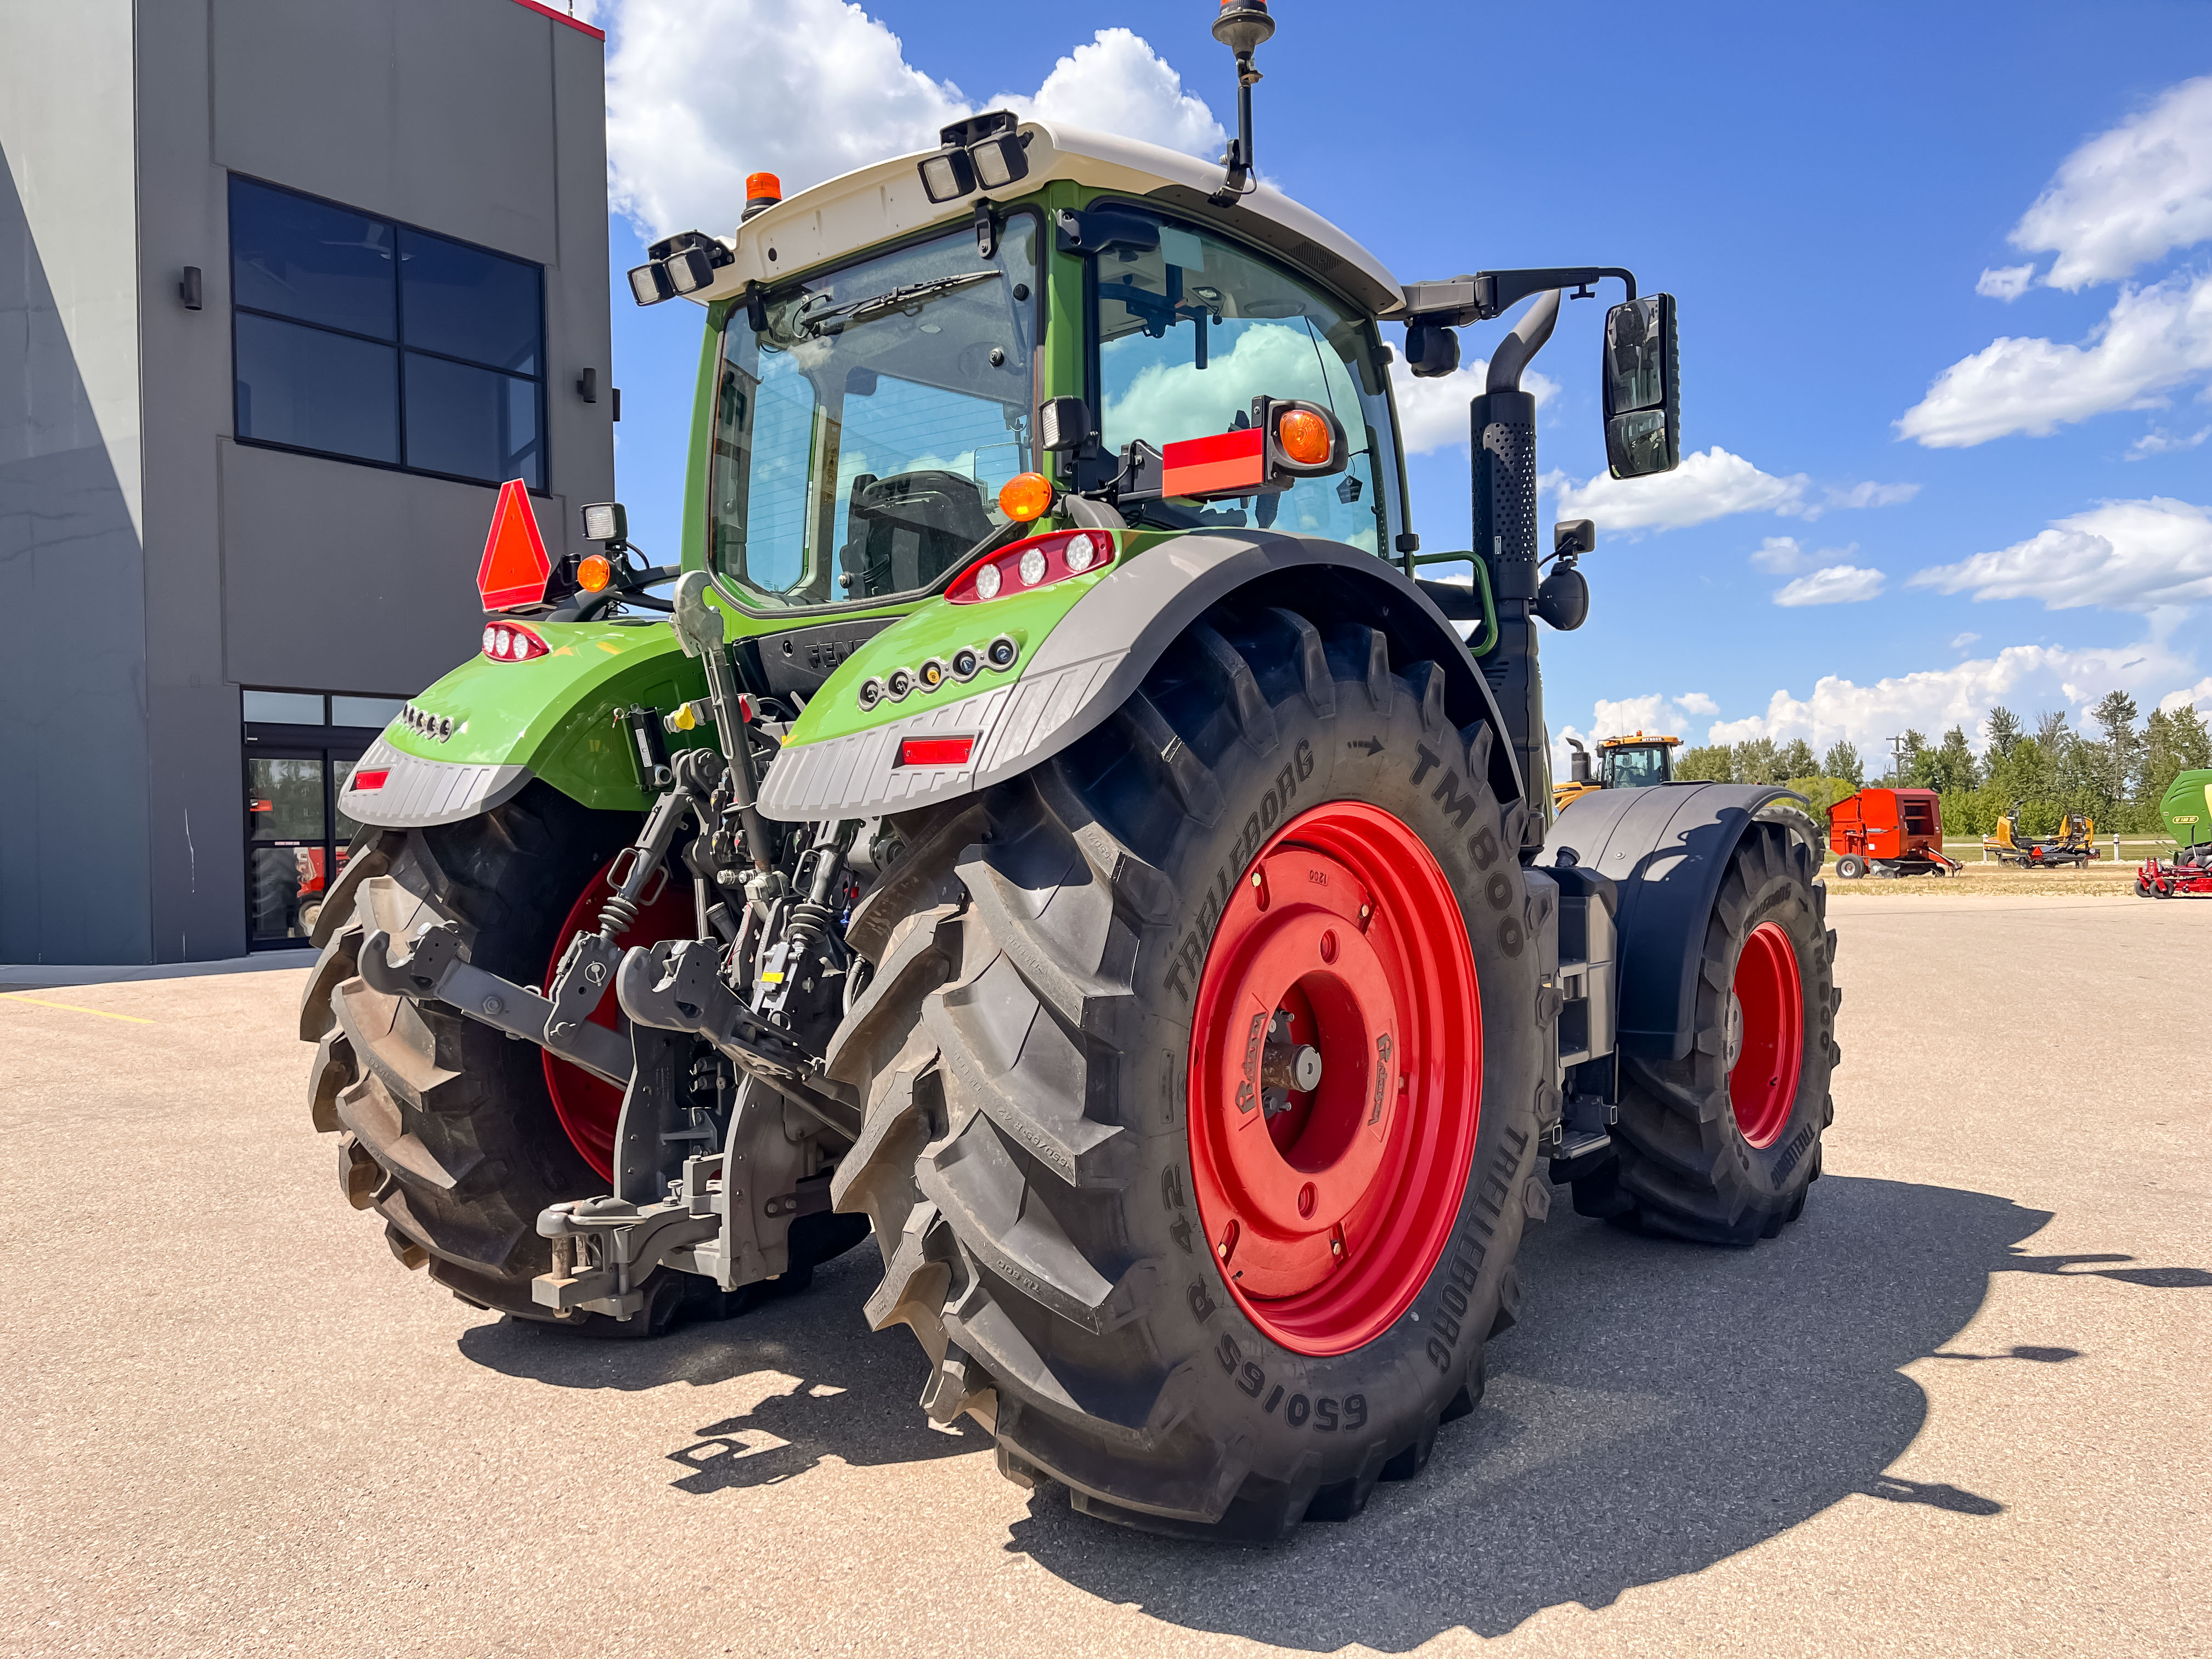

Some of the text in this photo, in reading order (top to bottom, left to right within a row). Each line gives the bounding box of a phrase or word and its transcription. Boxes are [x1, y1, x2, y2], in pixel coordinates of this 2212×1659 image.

[804, 639, 871, 669] FEN
[1164, 737, 1316, 1005] TRELLEBORG
[1025, 1129, 1068, 1169] 650/65
[1425, 1125, 1529, 1376] TRELLEBORG
[1162, 1163, 1368, 1432] 650/65 R 42
